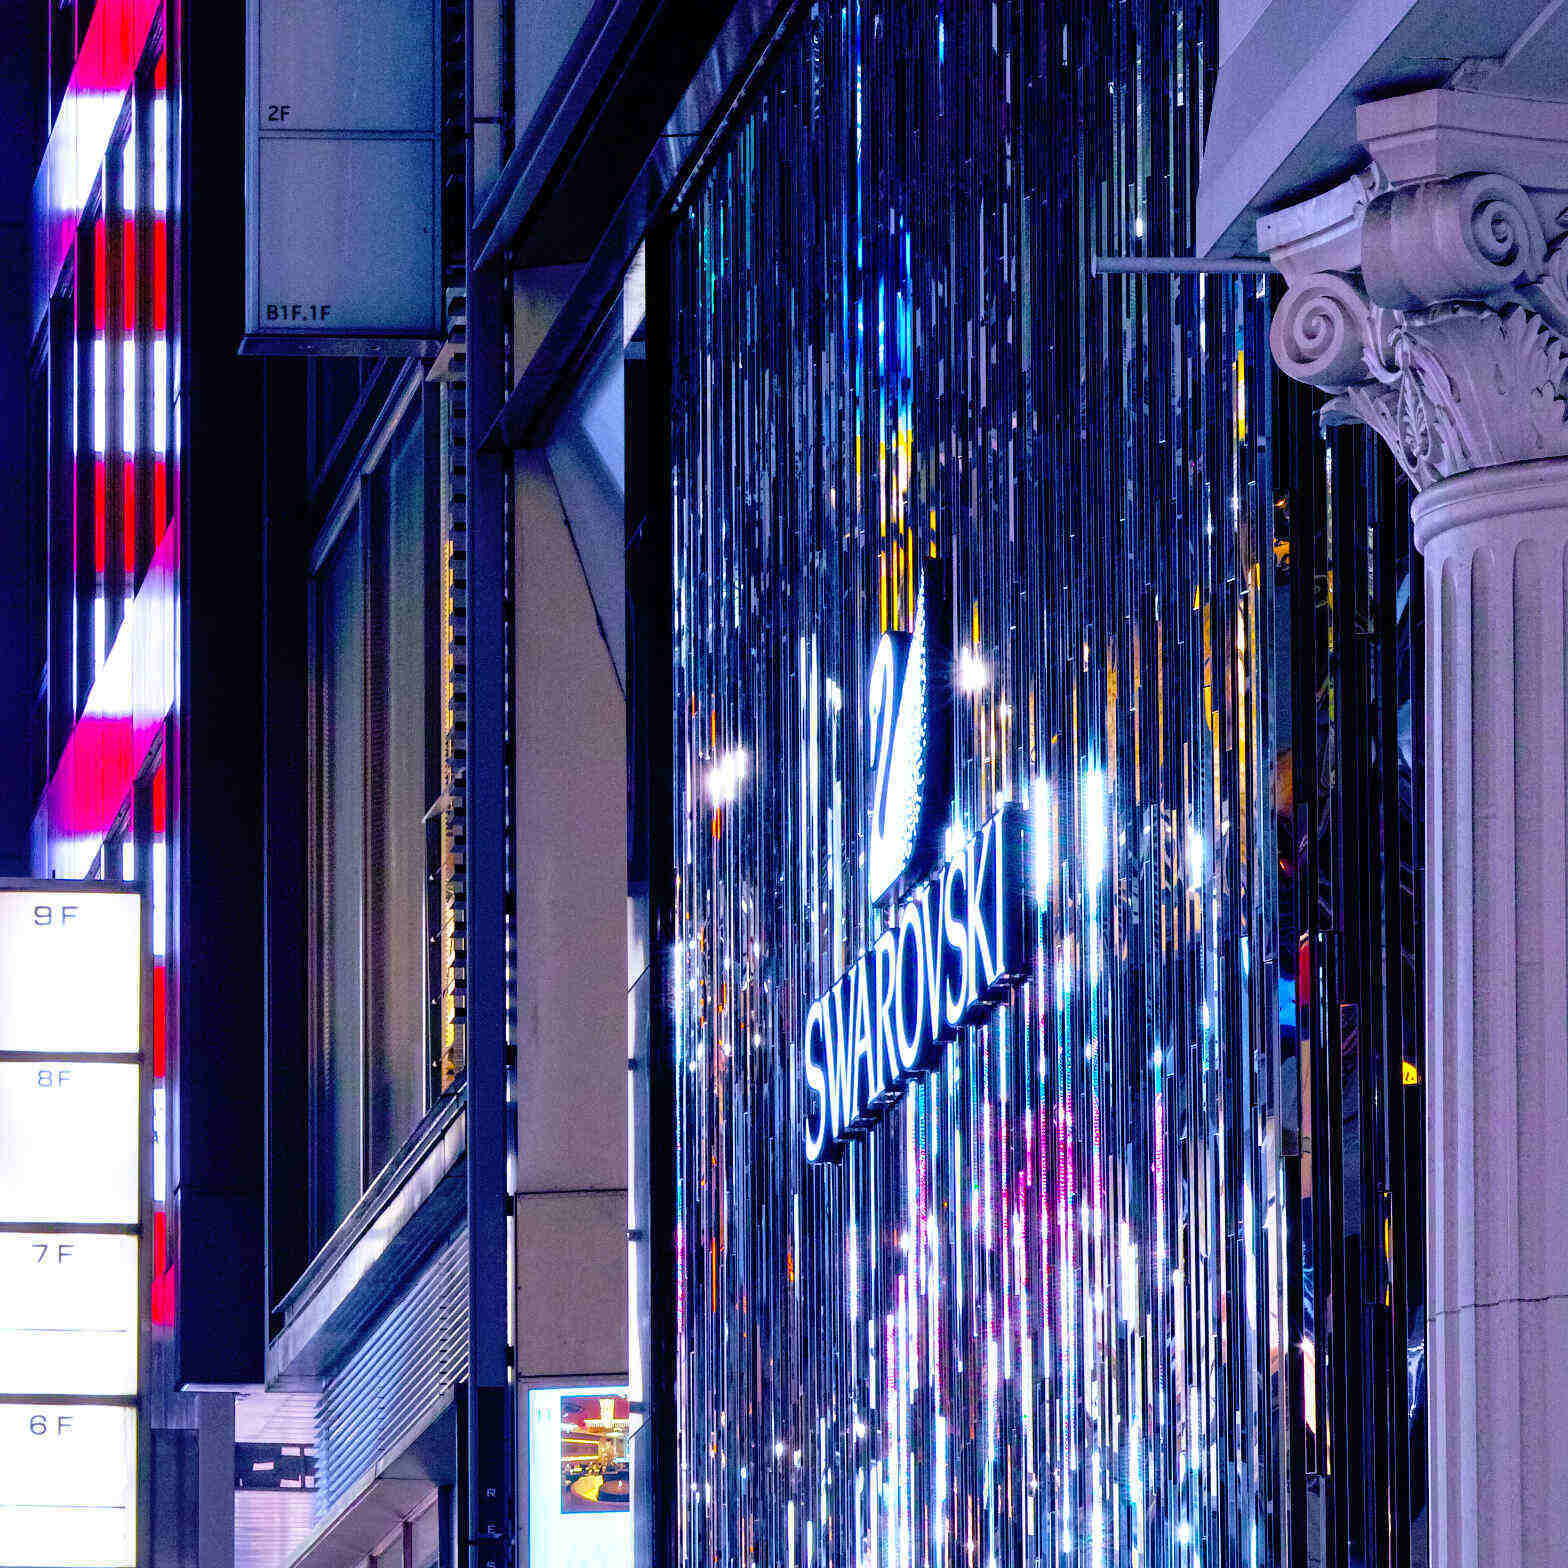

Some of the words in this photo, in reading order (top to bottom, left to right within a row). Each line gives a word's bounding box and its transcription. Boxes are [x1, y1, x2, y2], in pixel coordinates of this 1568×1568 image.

[267, 105, 291, 122] 2F
[33, 905, 79, 926] 9F
[804, 812, 1010, 1164] SWAROVSKI
[36, 1069, 73, 1088] 8F
[31, 1244, 75, 1264] 7F
[29, 1415, 74, 1436] 6F
